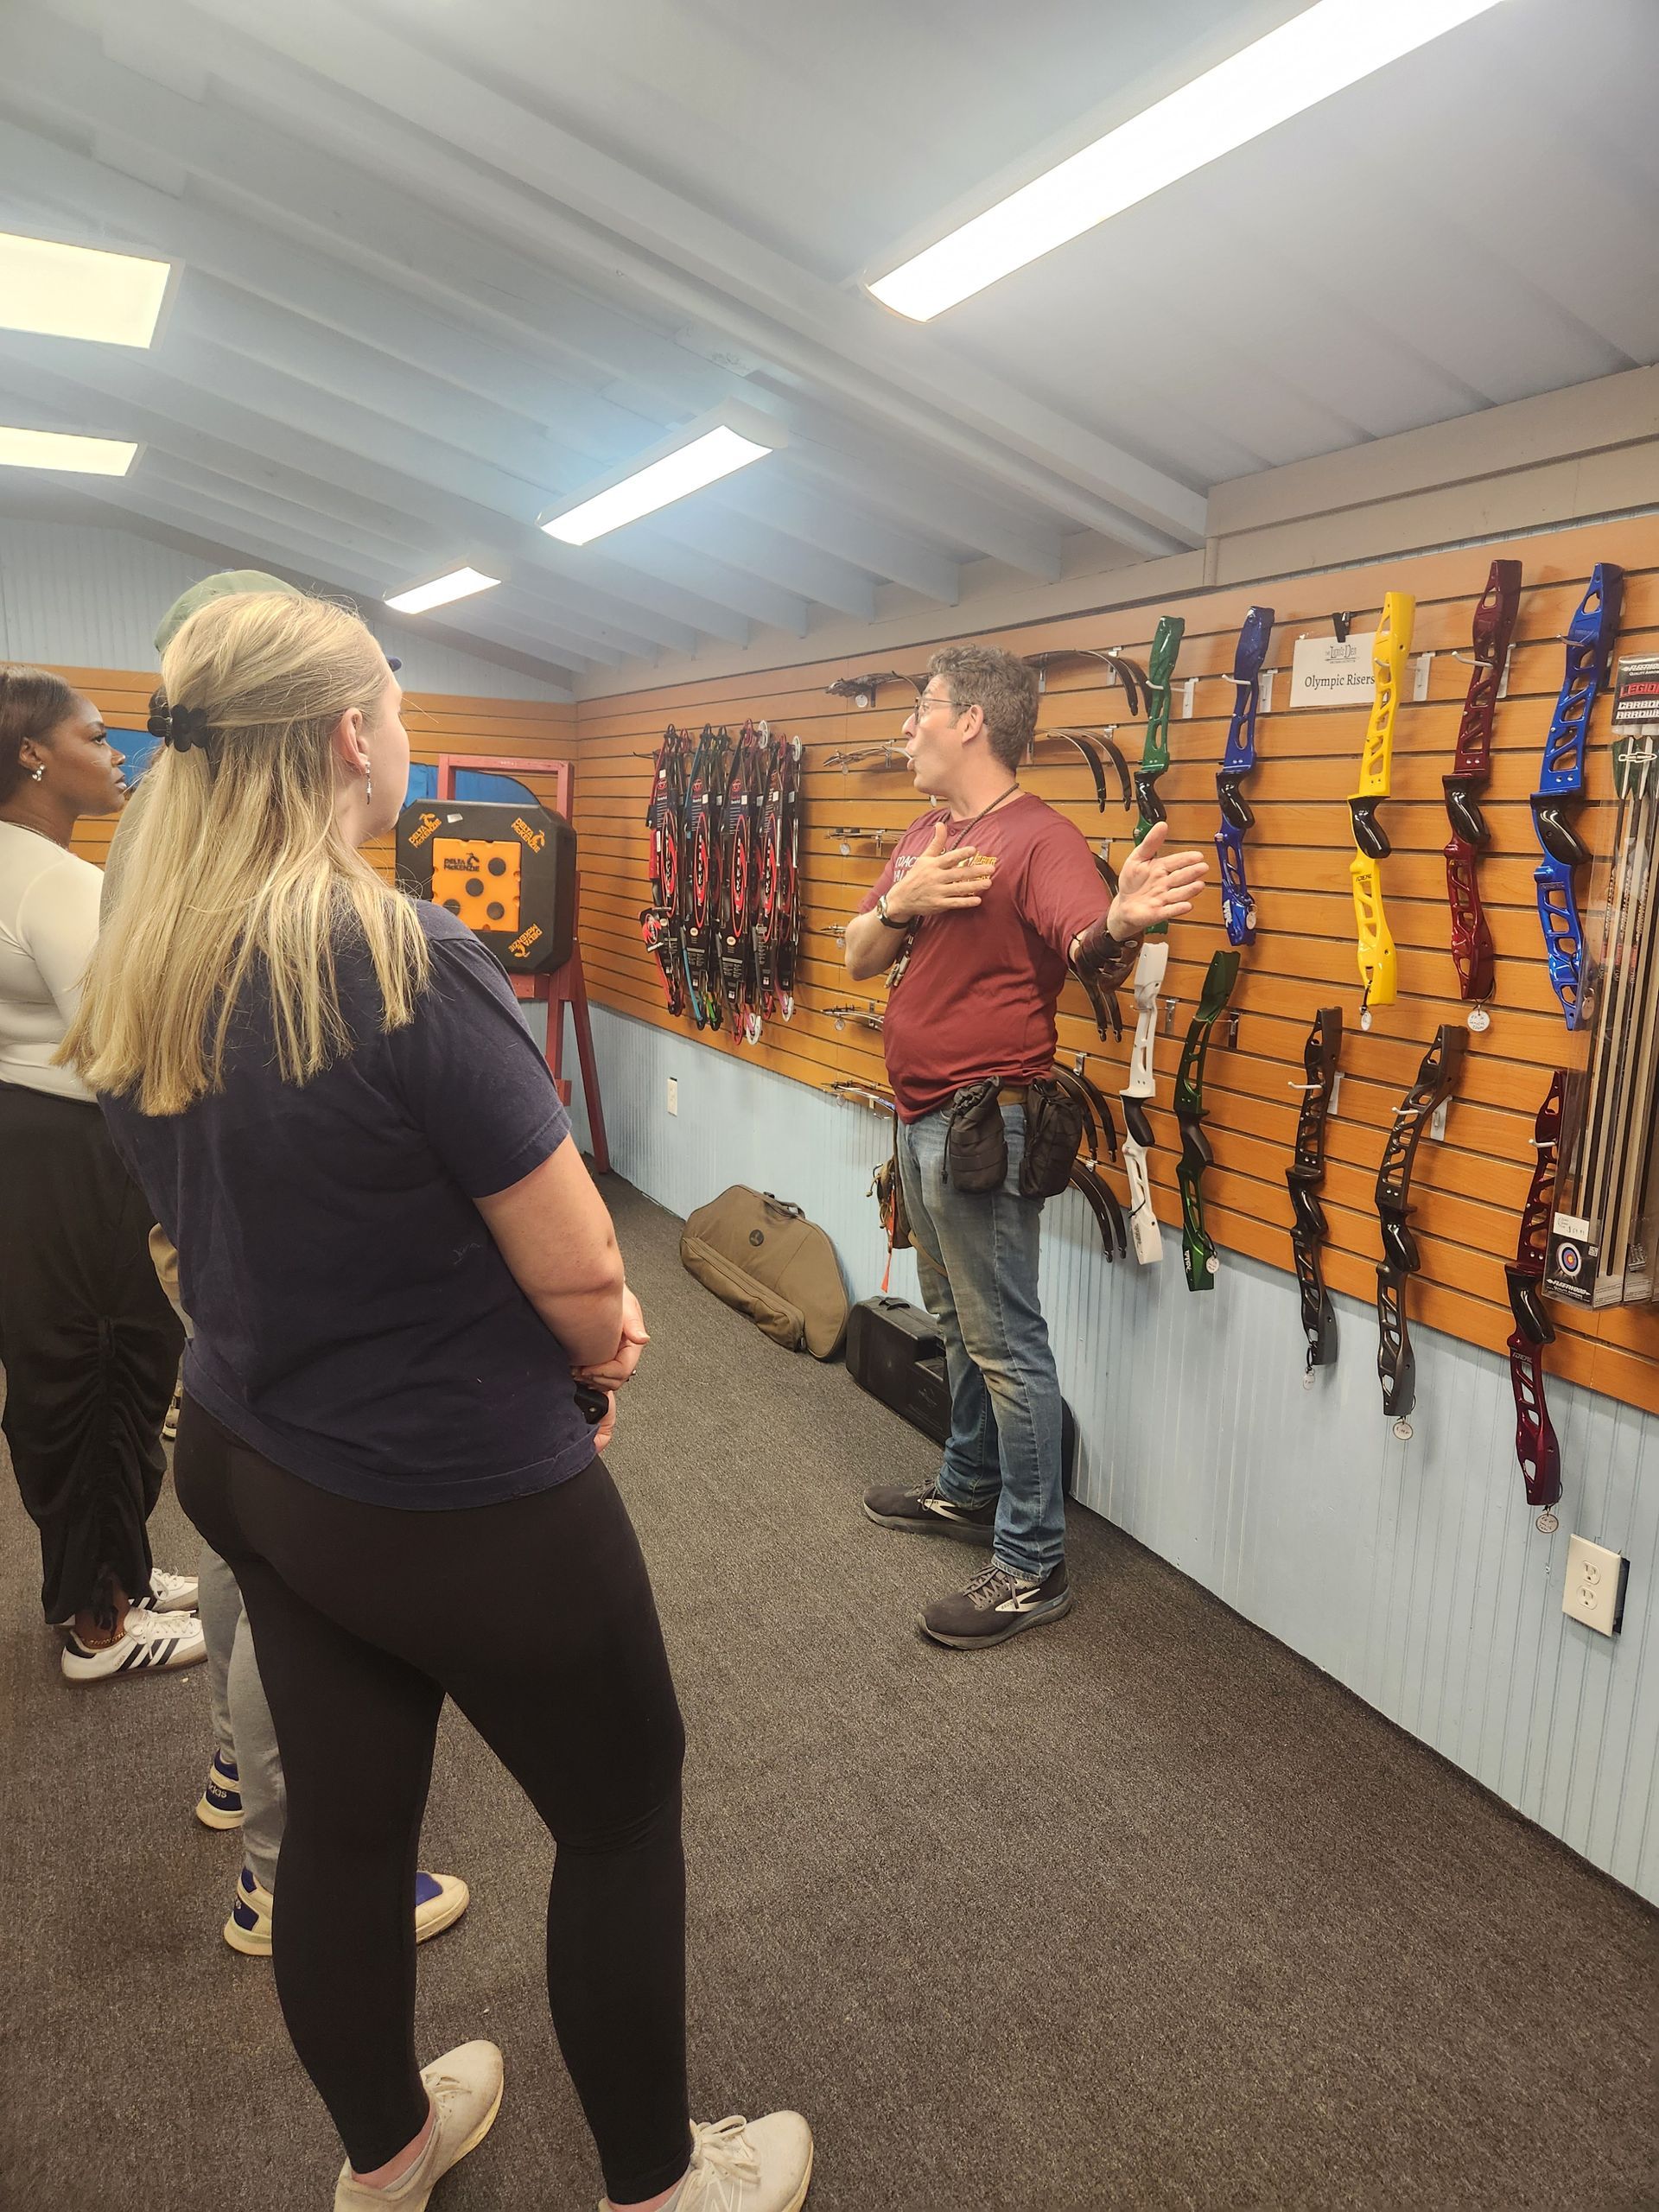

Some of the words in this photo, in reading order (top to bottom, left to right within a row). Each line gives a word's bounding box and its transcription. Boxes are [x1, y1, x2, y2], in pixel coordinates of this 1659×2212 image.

[1305, 673, 1344, 690] Olympic
[1346, 672, 1376, 685] Risers
[408, 825, 427, 844] DELTA
[515, 817, 534, 838] DELTA
[525, 928, 543, 946] DELTA
